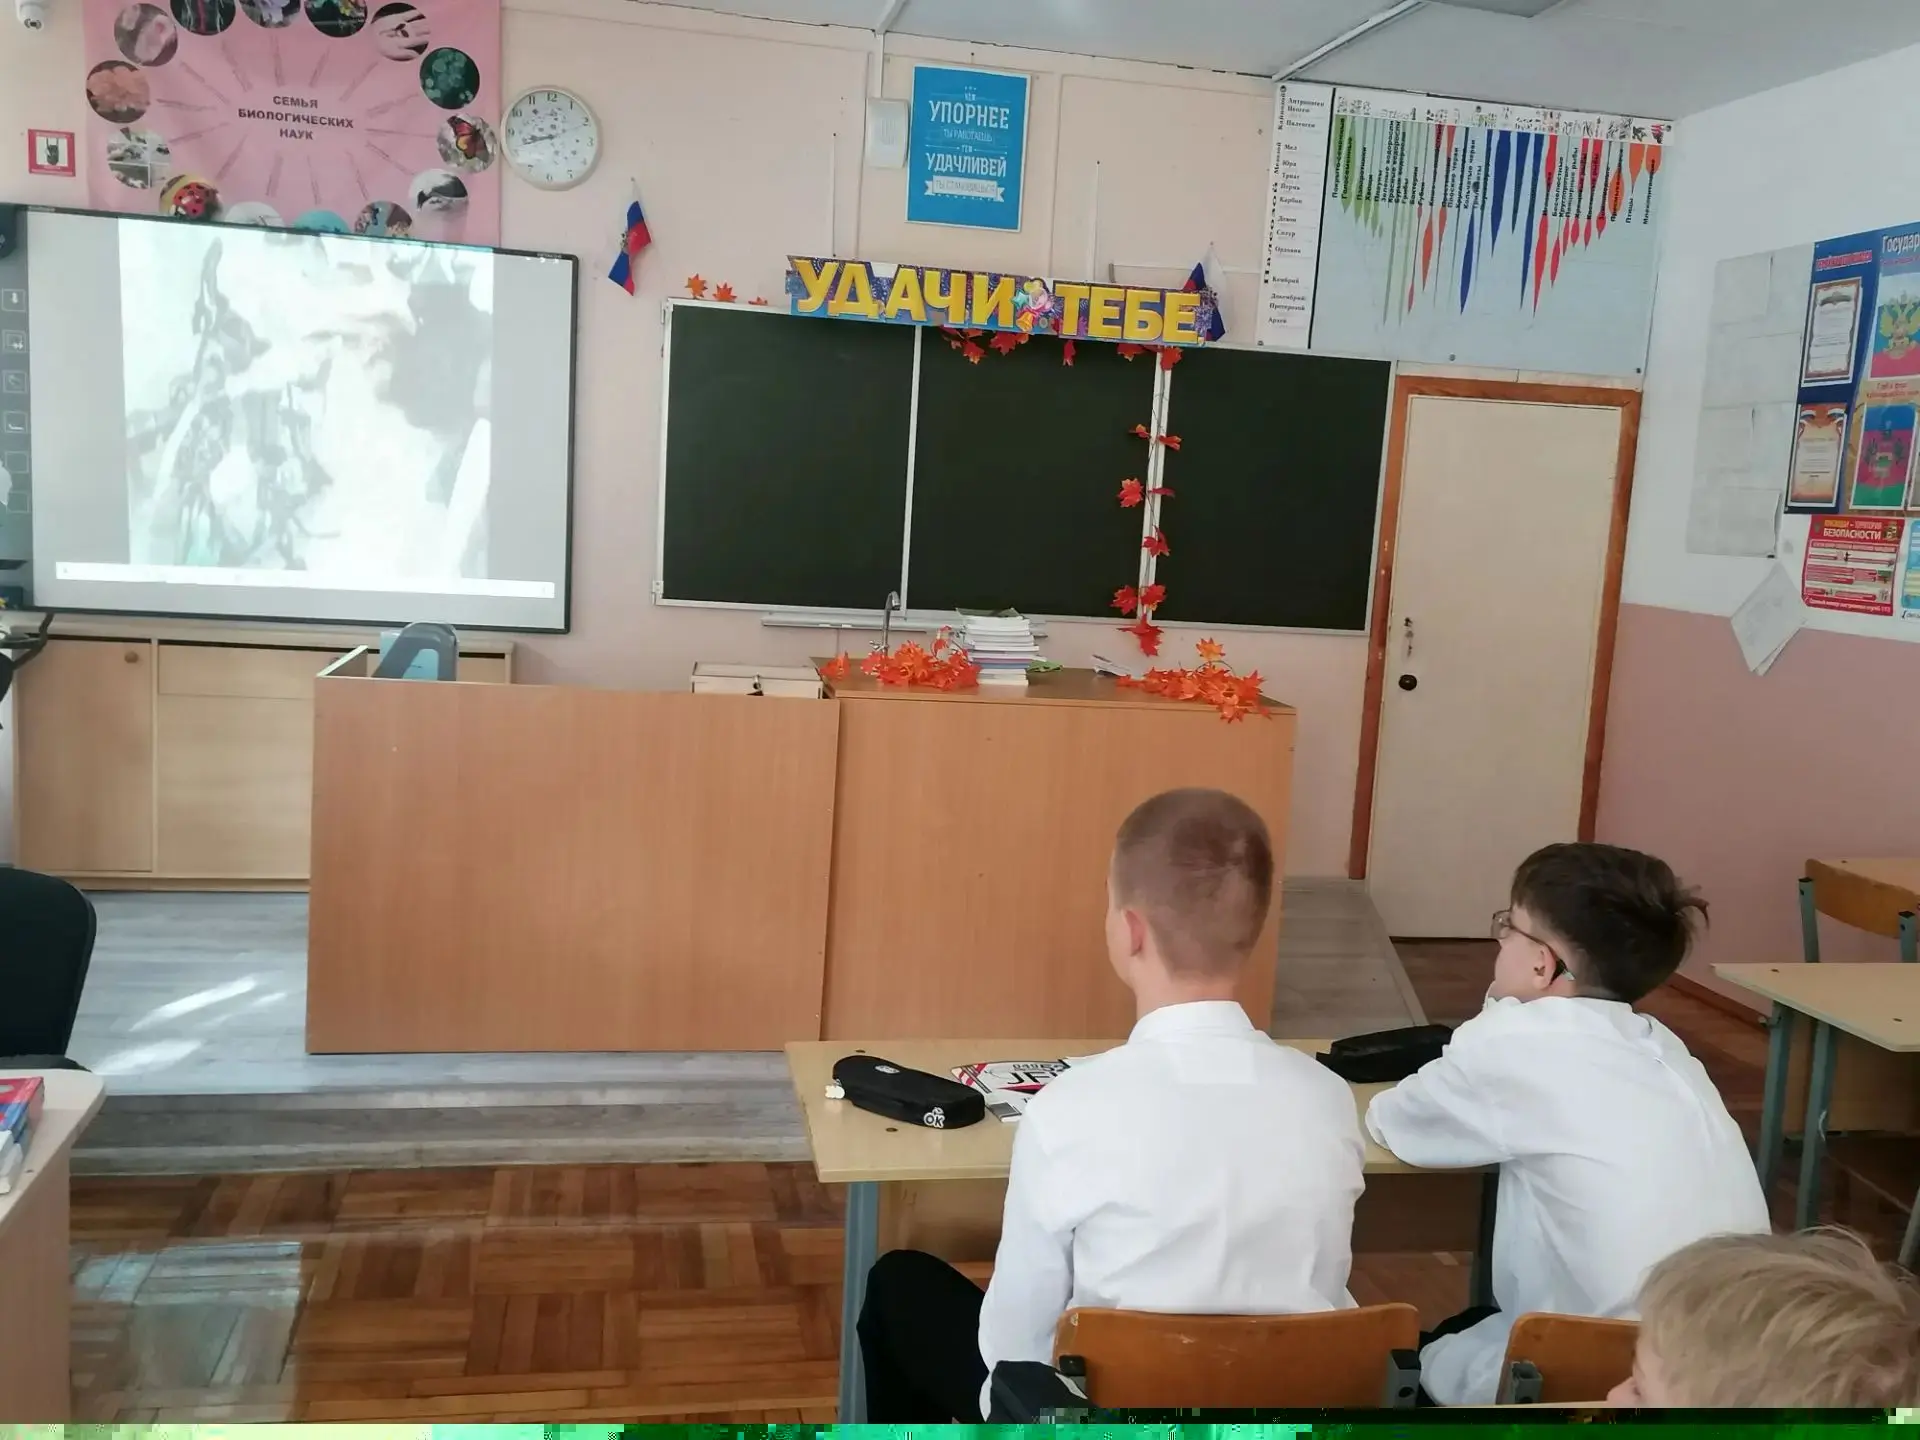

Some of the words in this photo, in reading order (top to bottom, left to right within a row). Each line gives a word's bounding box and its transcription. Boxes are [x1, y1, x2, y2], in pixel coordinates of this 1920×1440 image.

[273, 95, 318, 109] СЕМЬЯ
[547, 92, 558, 102] 12
[238, 108, 354, 128] БИОЛОГИЧЕСКИХ
[512, 108, 522, 118] 10
[929, 100, 1010, 130] УПОРНЕЕ
[279, 128, 313, 140] НАУК
[925, 152, 1007, 178] УДАЧЛИВЕЙ
[792, 258, 1016, 328] УДАЧИ
[1054, 283, 1202, 345] ТЕБЕ
[1823, 527, 1882, 540] БЕЗОПАСНОСТИ
[925, 1115, 944, 1127] OK
